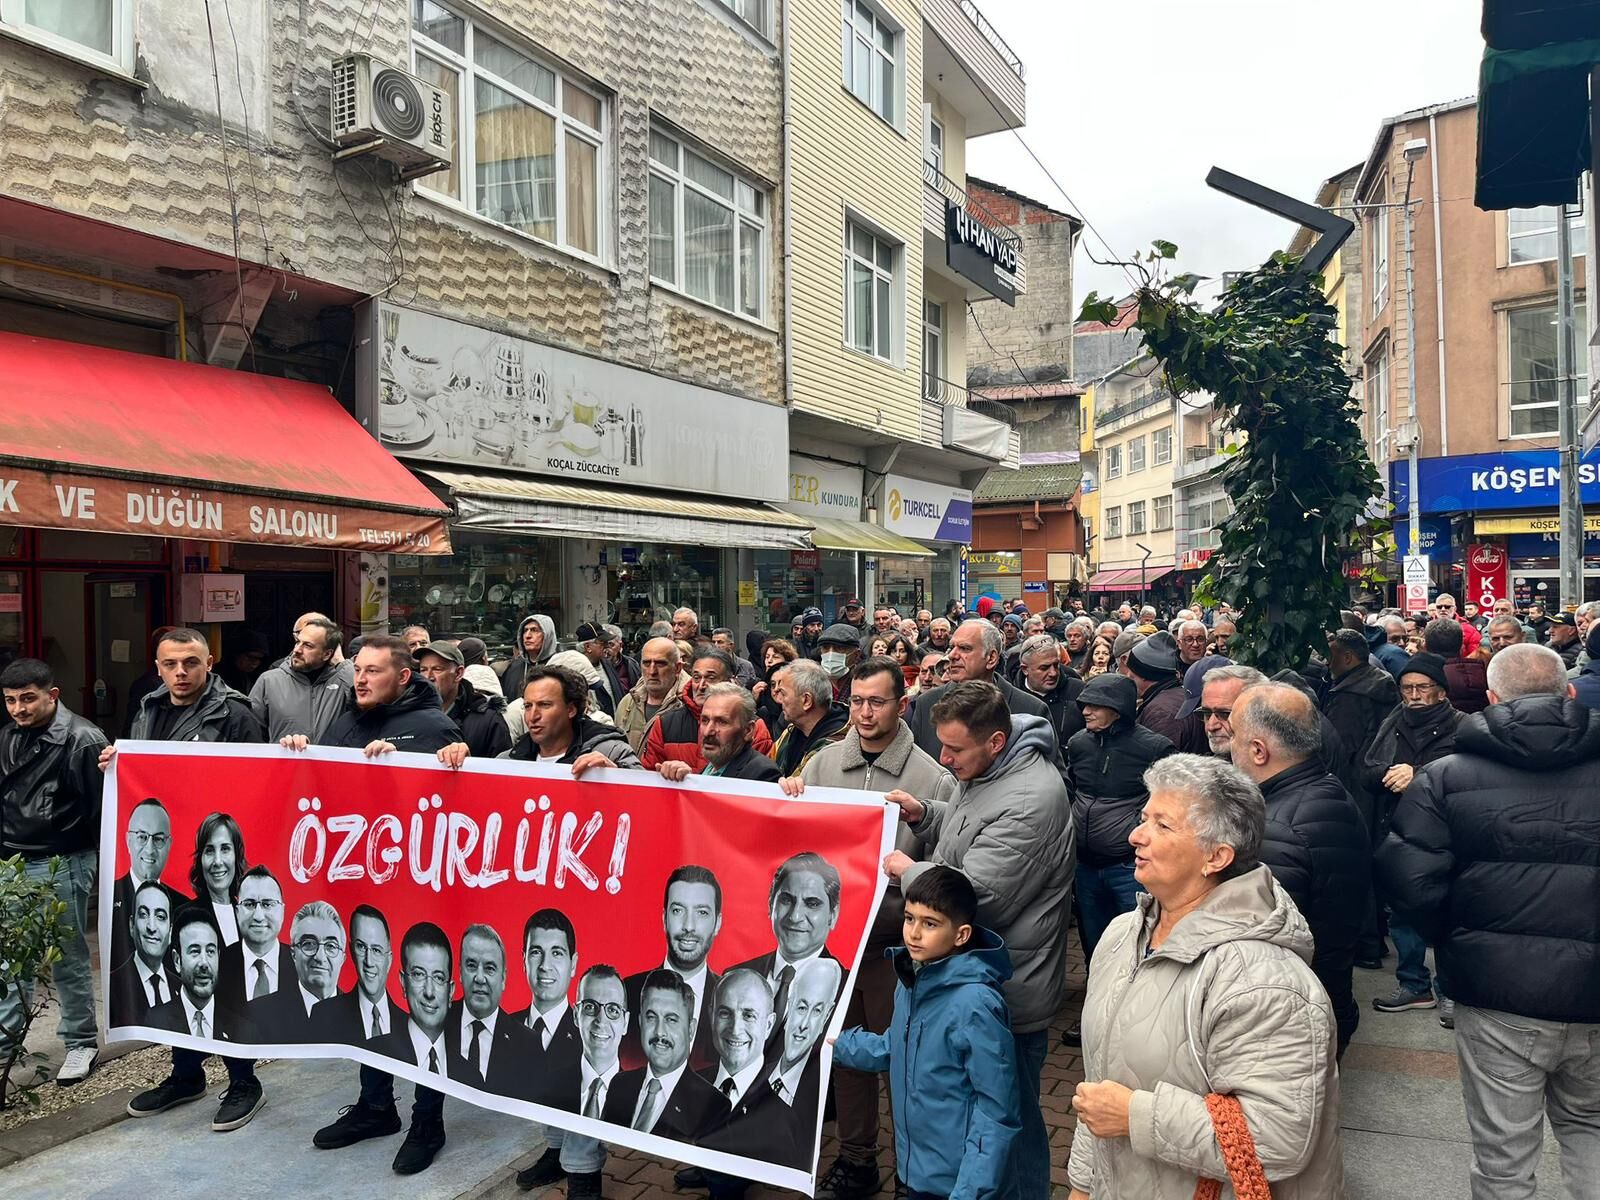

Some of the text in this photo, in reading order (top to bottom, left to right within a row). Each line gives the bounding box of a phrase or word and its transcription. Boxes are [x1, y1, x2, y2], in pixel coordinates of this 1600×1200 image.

[432, 91, 442, 145] BOSCH
[970, 219, 995, 257] HAN
[547, 457, 620, 476] KOÇAL ZÜCCACİYE
[1472, 463, 1600, 493] KÖŞEM S
[789, 473, 859, 508] ER KUNDURA
[55, 485, 96, 520] VE
[127, 488, 223, 531] DÜĞÜN
[250, 505, 338, 540] SALONU
[903, 499, 941, 519] TURKCELL
[289, 793, 631, 894] ÖZGÜRLÜK!
